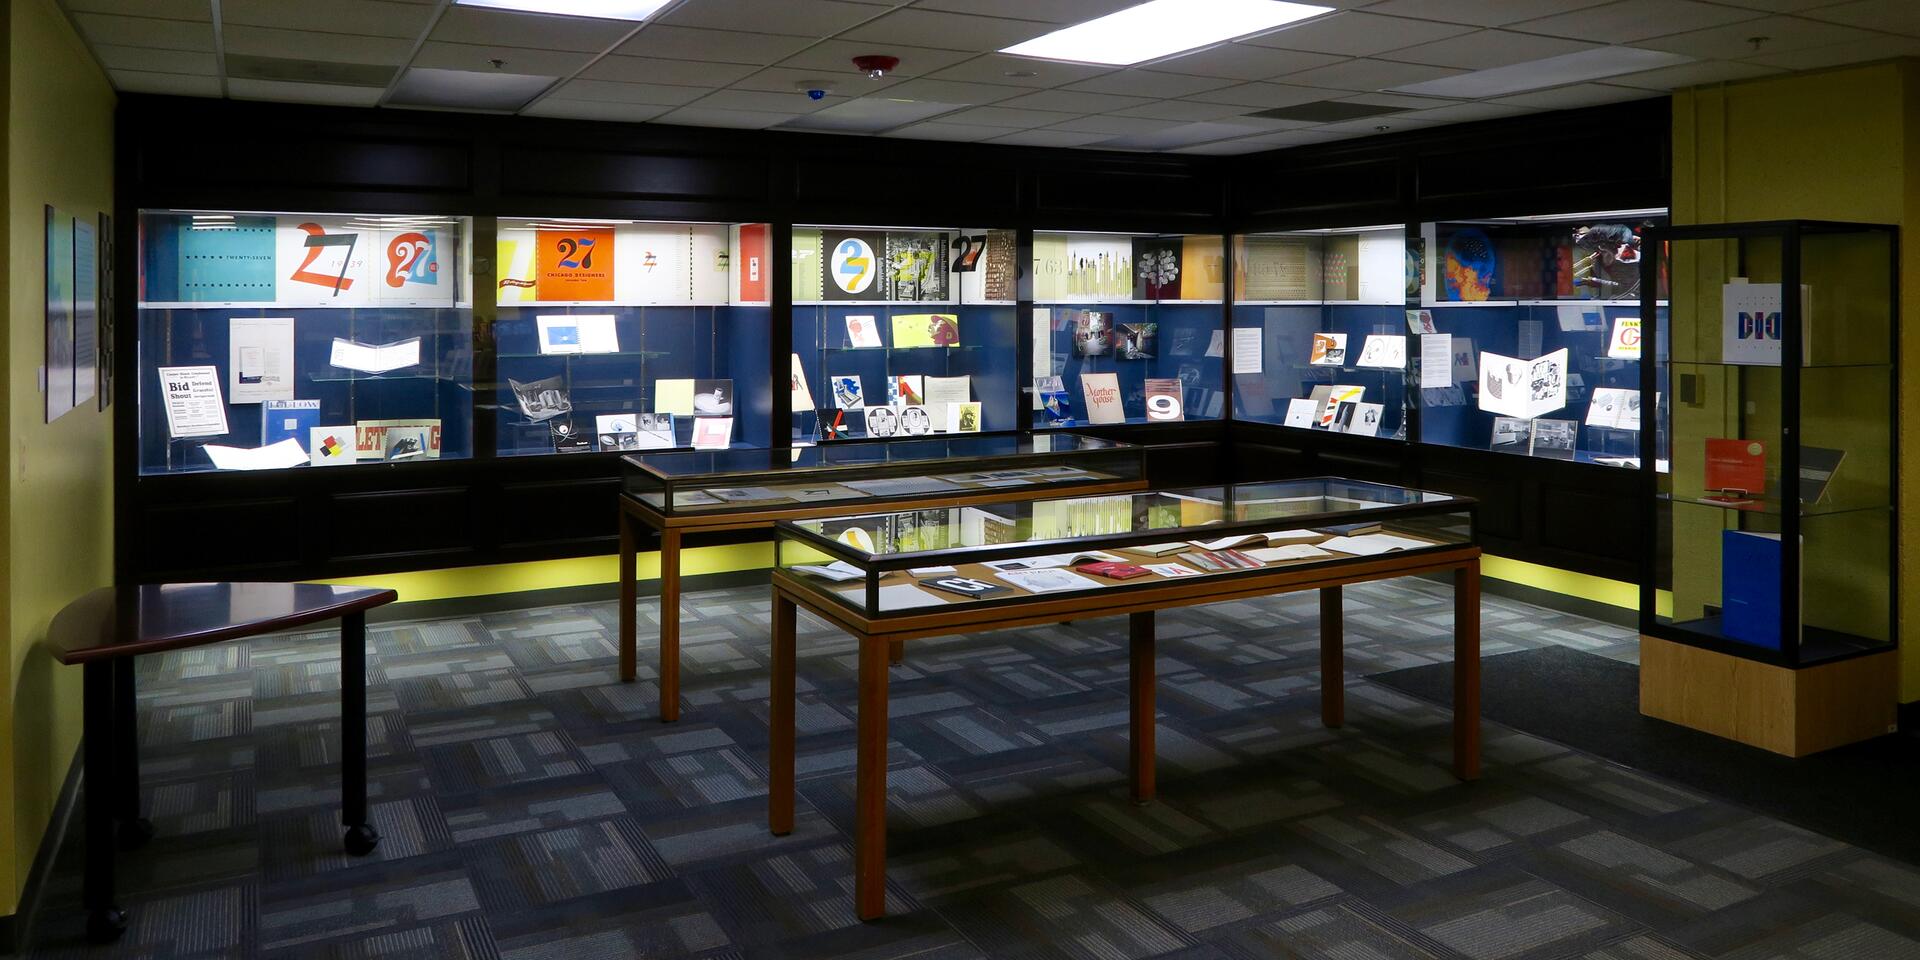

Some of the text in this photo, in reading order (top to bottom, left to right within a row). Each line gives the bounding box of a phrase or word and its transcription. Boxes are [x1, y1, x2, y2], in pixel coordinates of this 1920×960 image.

[290, 222, 358, 297] 27
[395, 240, 432, 279] 27
[557, 237, 596, 269] 27
[840, 240, 869, 290] 27
[951, 234, 987, 273] 27
[168, 382, 190, 391] Bid
[1086, 383, 1117, 396] Mother
[1092, 396, 1114, 408] Goose
[1147, 395, 1181, 420] 9
